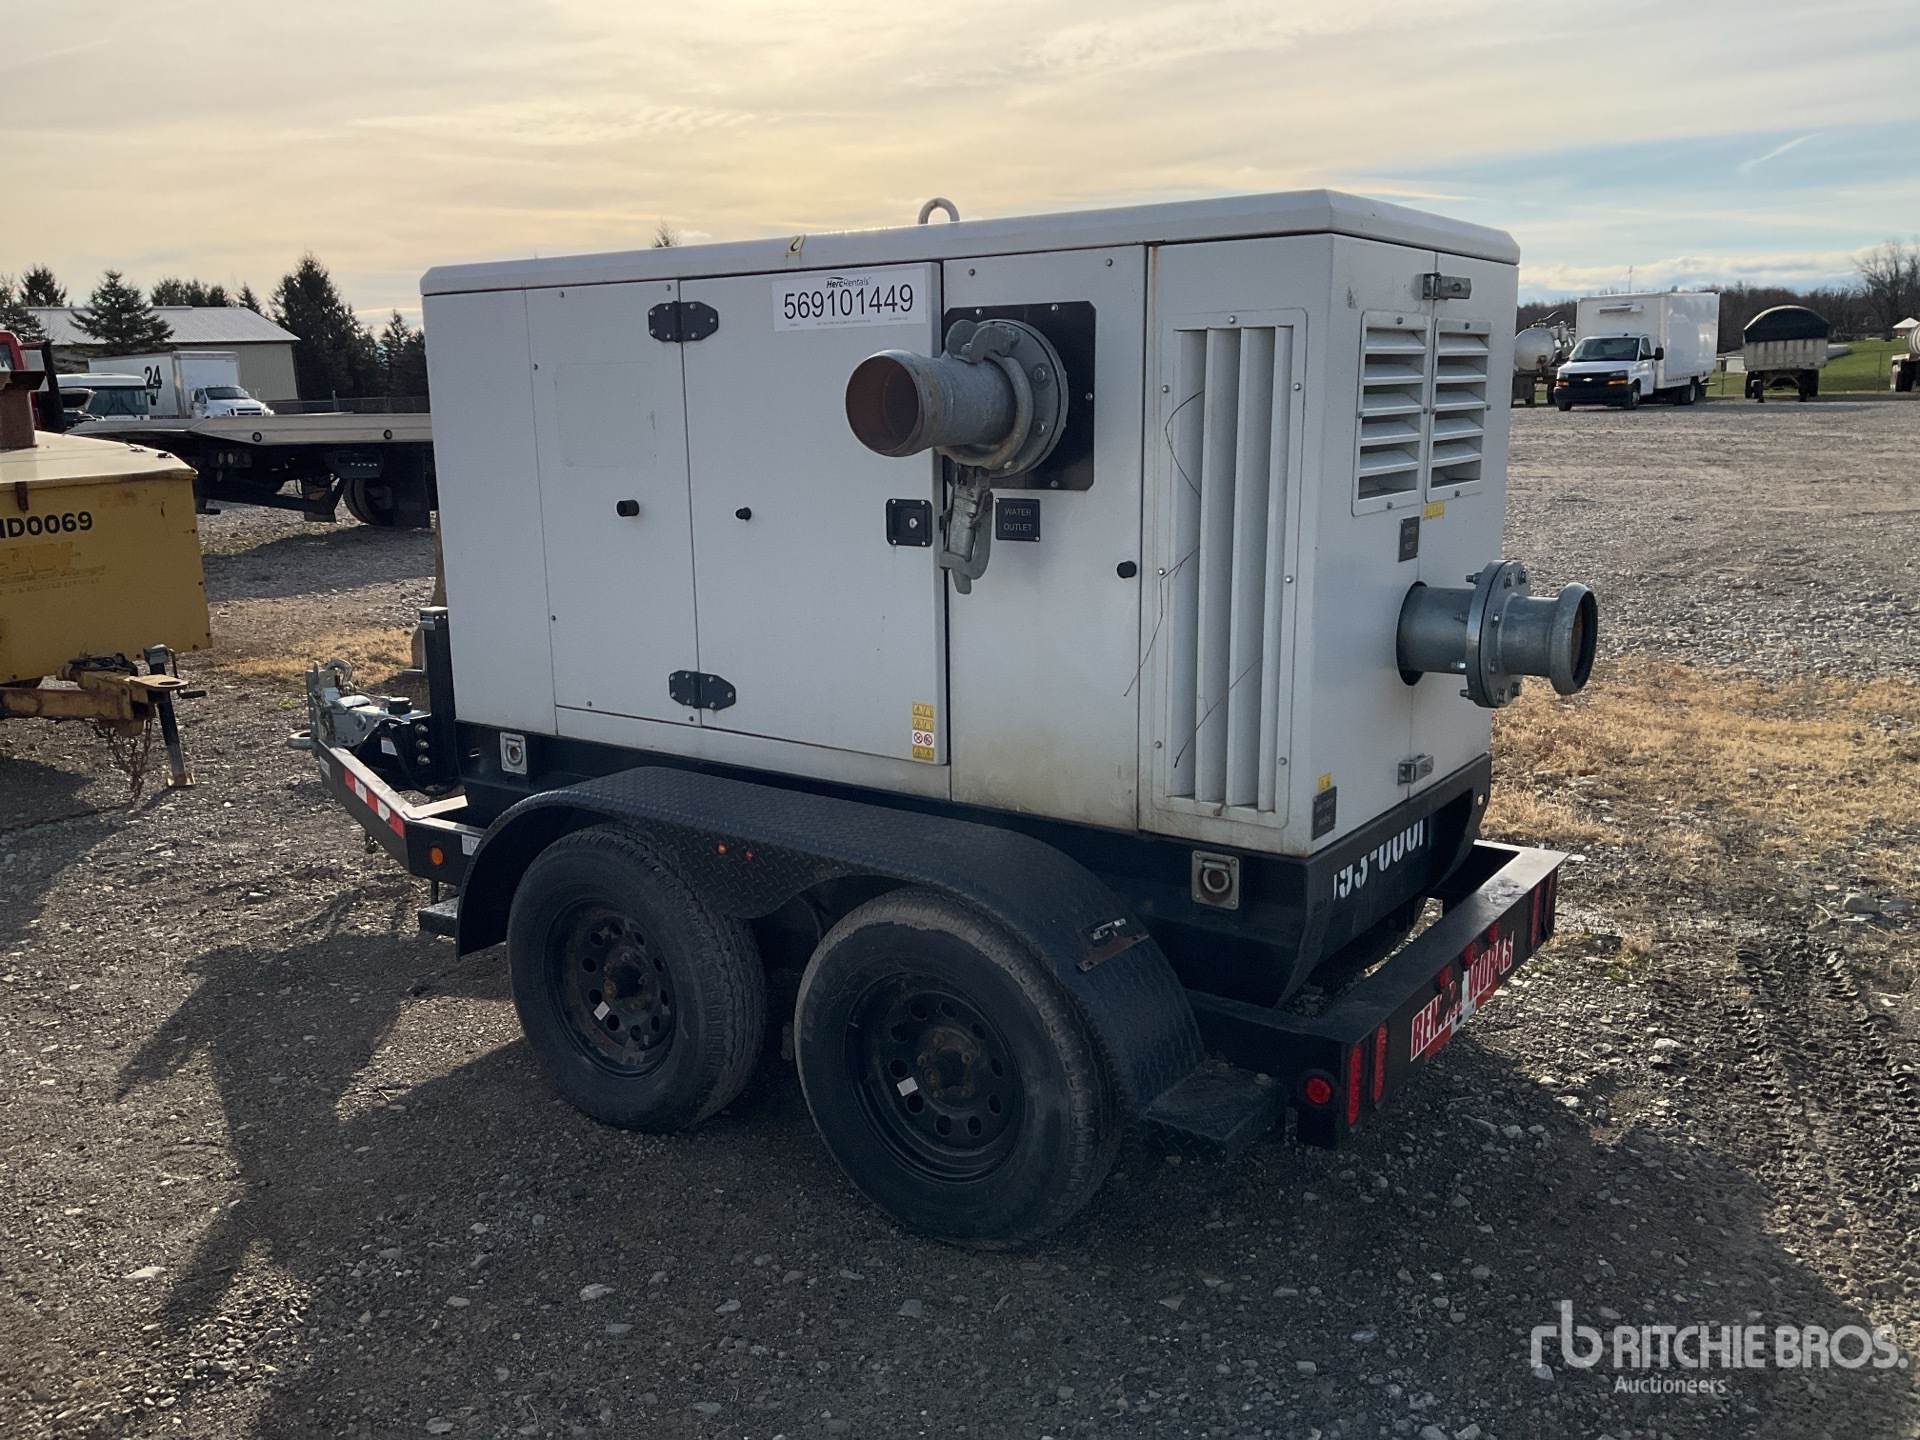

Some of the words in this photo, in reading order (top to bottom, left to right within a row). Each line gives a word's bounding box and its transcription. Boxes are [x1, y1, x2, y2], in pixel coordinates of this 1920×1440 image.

[784, 284, 913, 319] 569101449
[145, 365, 162, 389] 24
[1005, 508, 1031, 516] WATER
[1003, 523, 1032, 531] OUTLET
